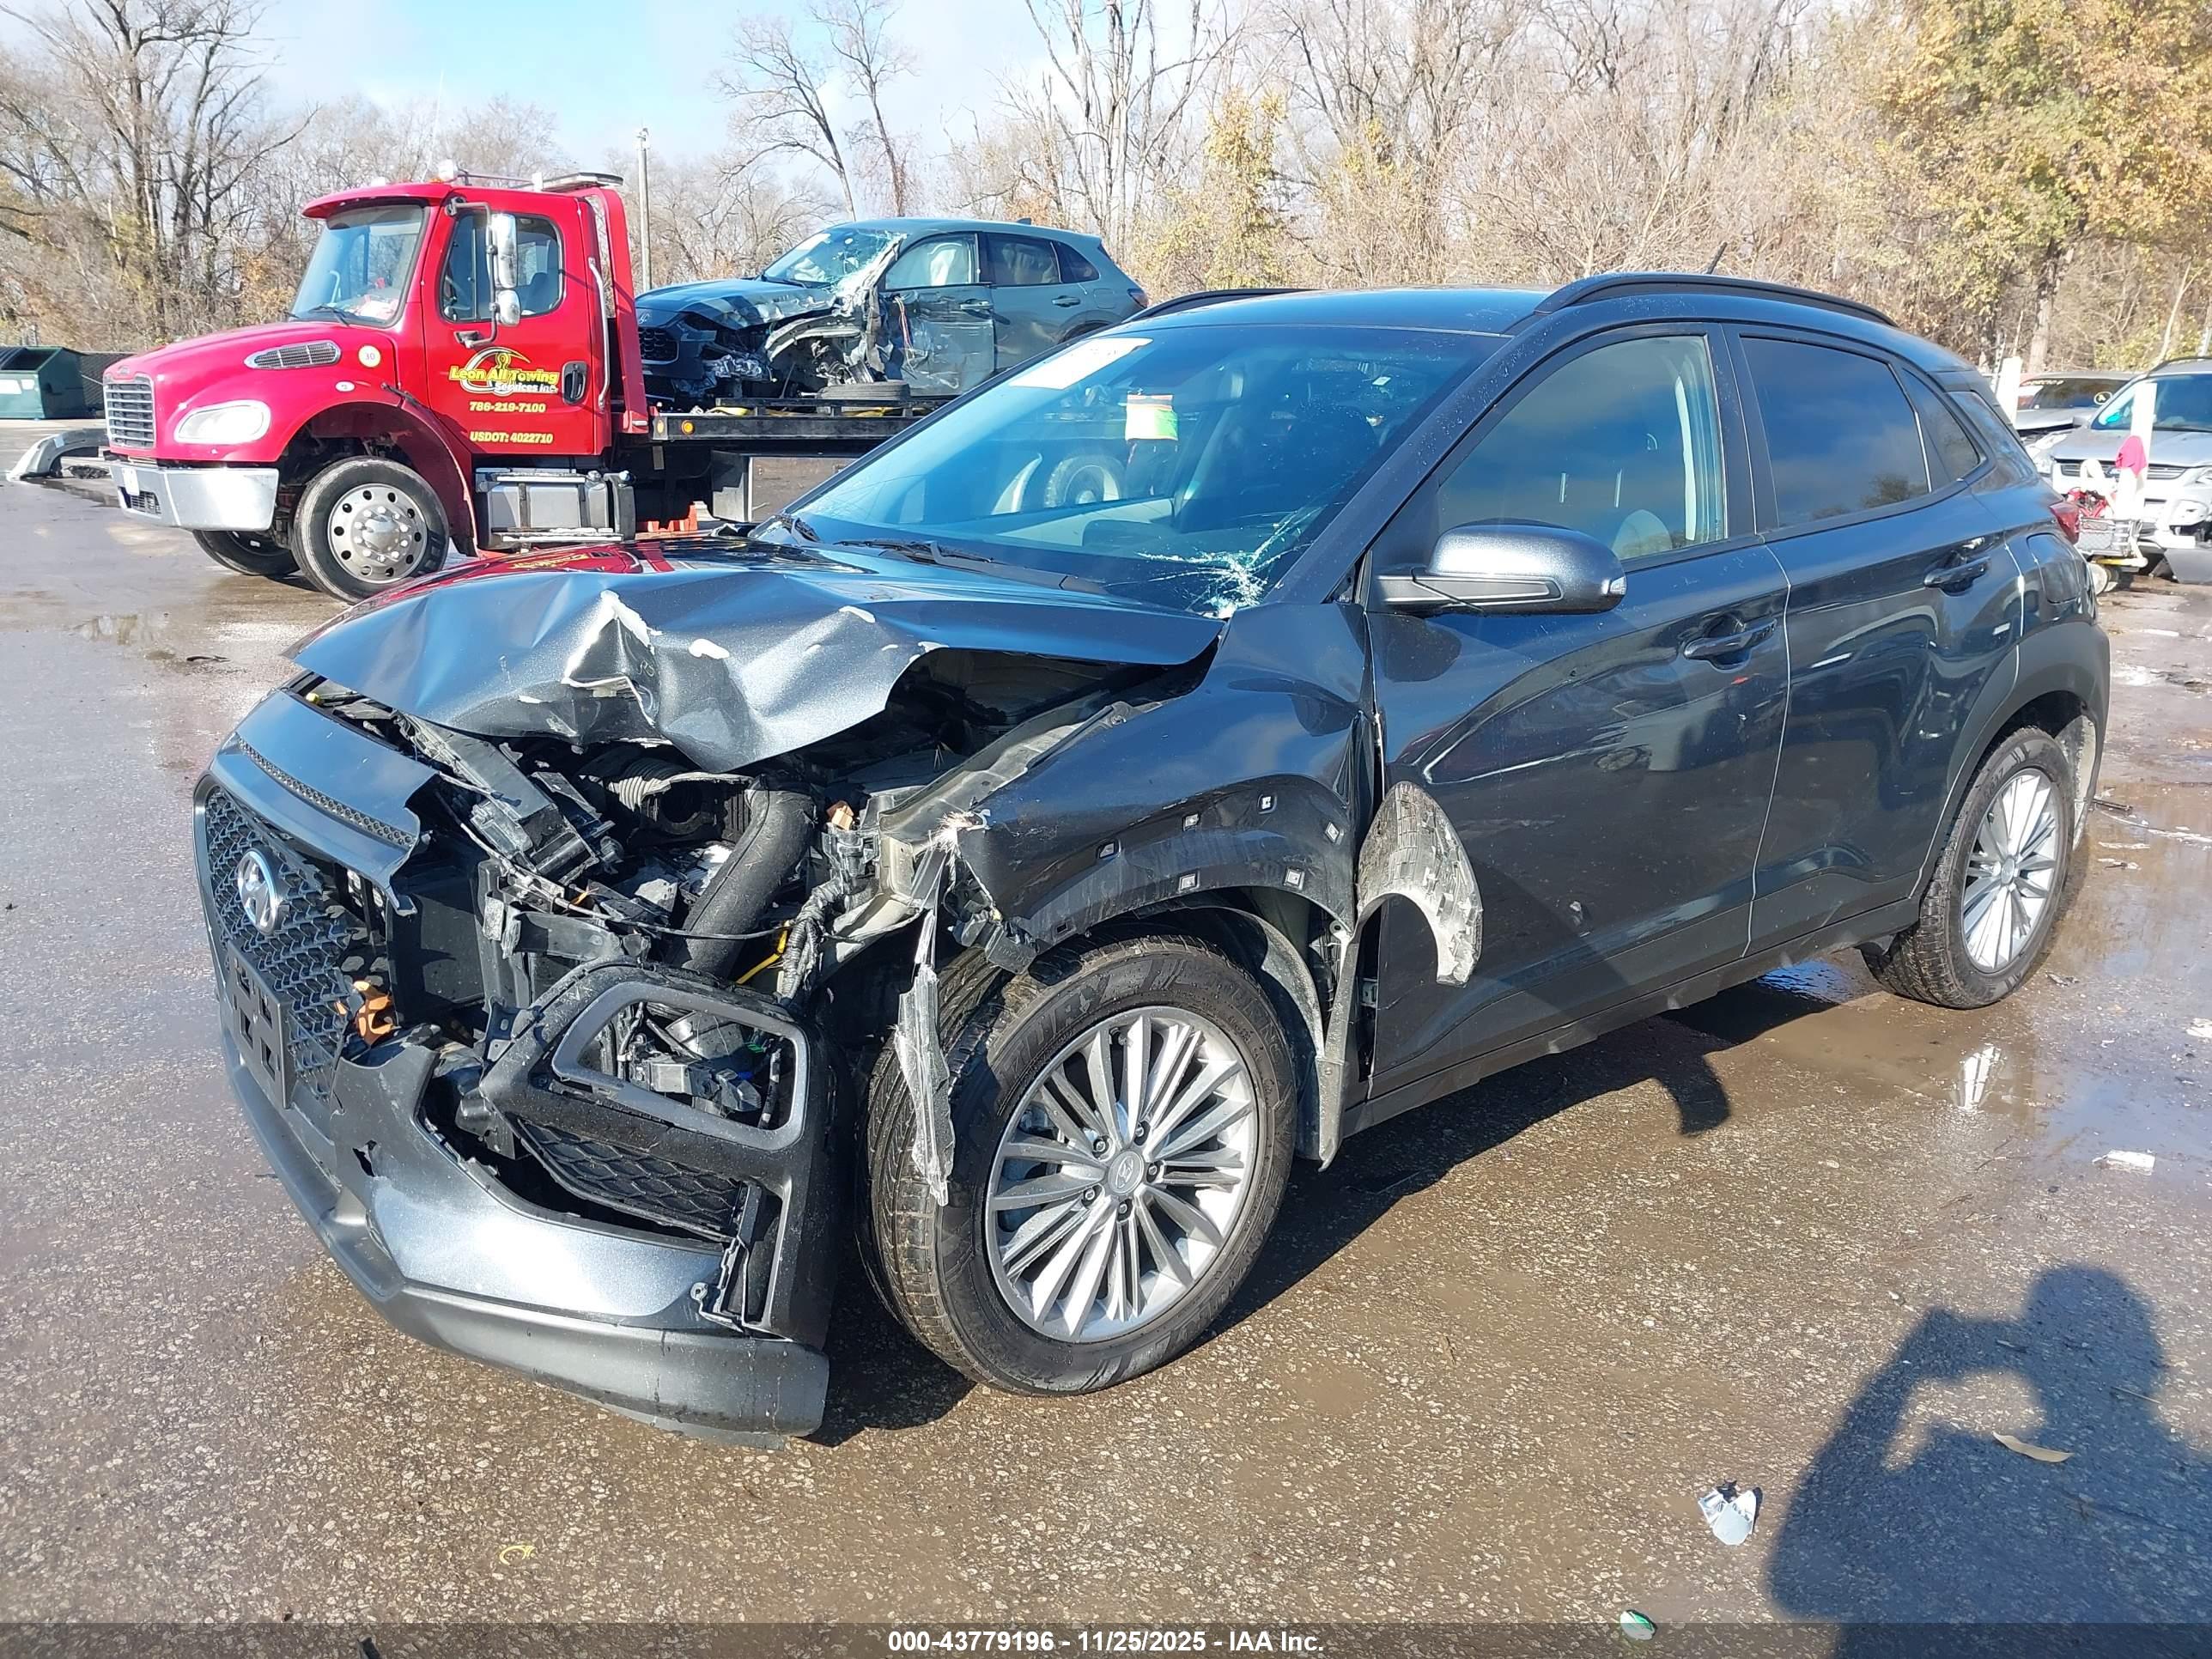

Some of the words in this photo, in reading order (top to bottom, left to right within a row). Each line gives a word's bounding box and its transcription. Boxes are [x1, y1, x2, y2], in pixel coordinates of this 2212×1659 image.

[450, 367, 486, 380] Leon
[487, 368, 508, 380] All
[509, 369, 557, 384] Towing
[469, 401, 546, 412] 786-219-7100
[470, 431, 509, 442] USDOT:
[510, 433, 553, 444] 4022710
